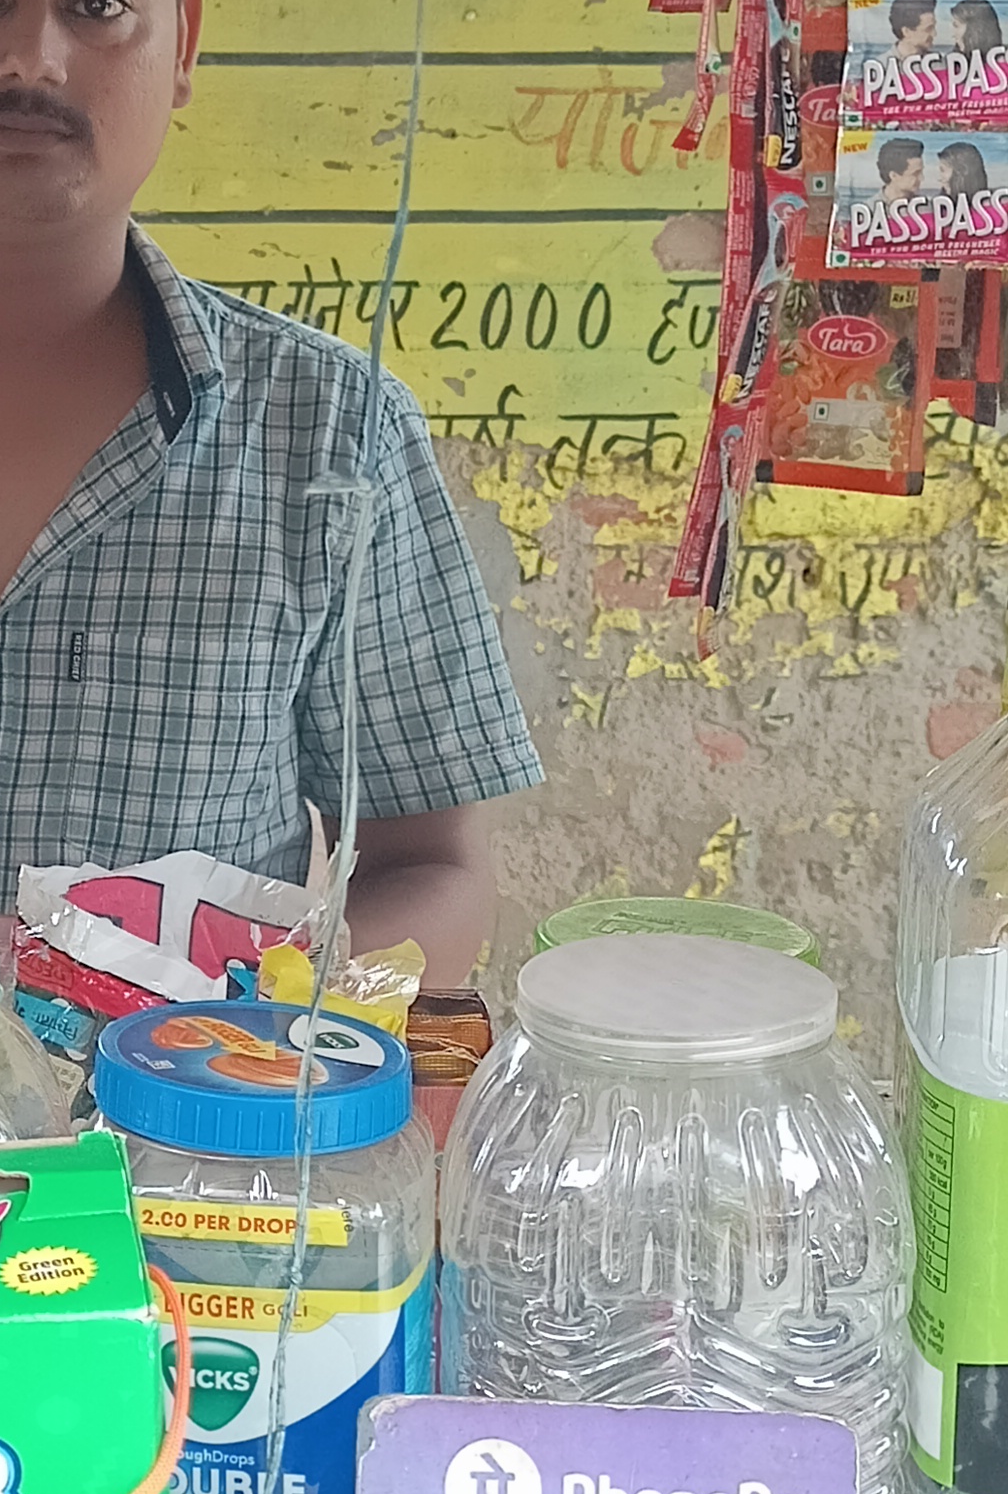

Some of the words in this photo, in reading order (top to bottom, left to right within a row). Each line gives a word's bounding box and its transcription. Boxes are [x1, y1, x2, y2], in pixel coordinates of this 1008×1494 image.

[863, 52, 942, 107] PASS
[843, 143, 868, 154] NEW
[851, 197, 928, 248] PASS
[933, 187, 1008, 241] PASS
[431, 281, 612, 350] 2000
[819, 328, 878, 354] Tara
[194, 1214, 230, 1231] PER
[18, 1255, 74, 1273] Green
[17, 1266, 85, 1286] Edition
[178, 1449, 255, 1466] oughDrops
